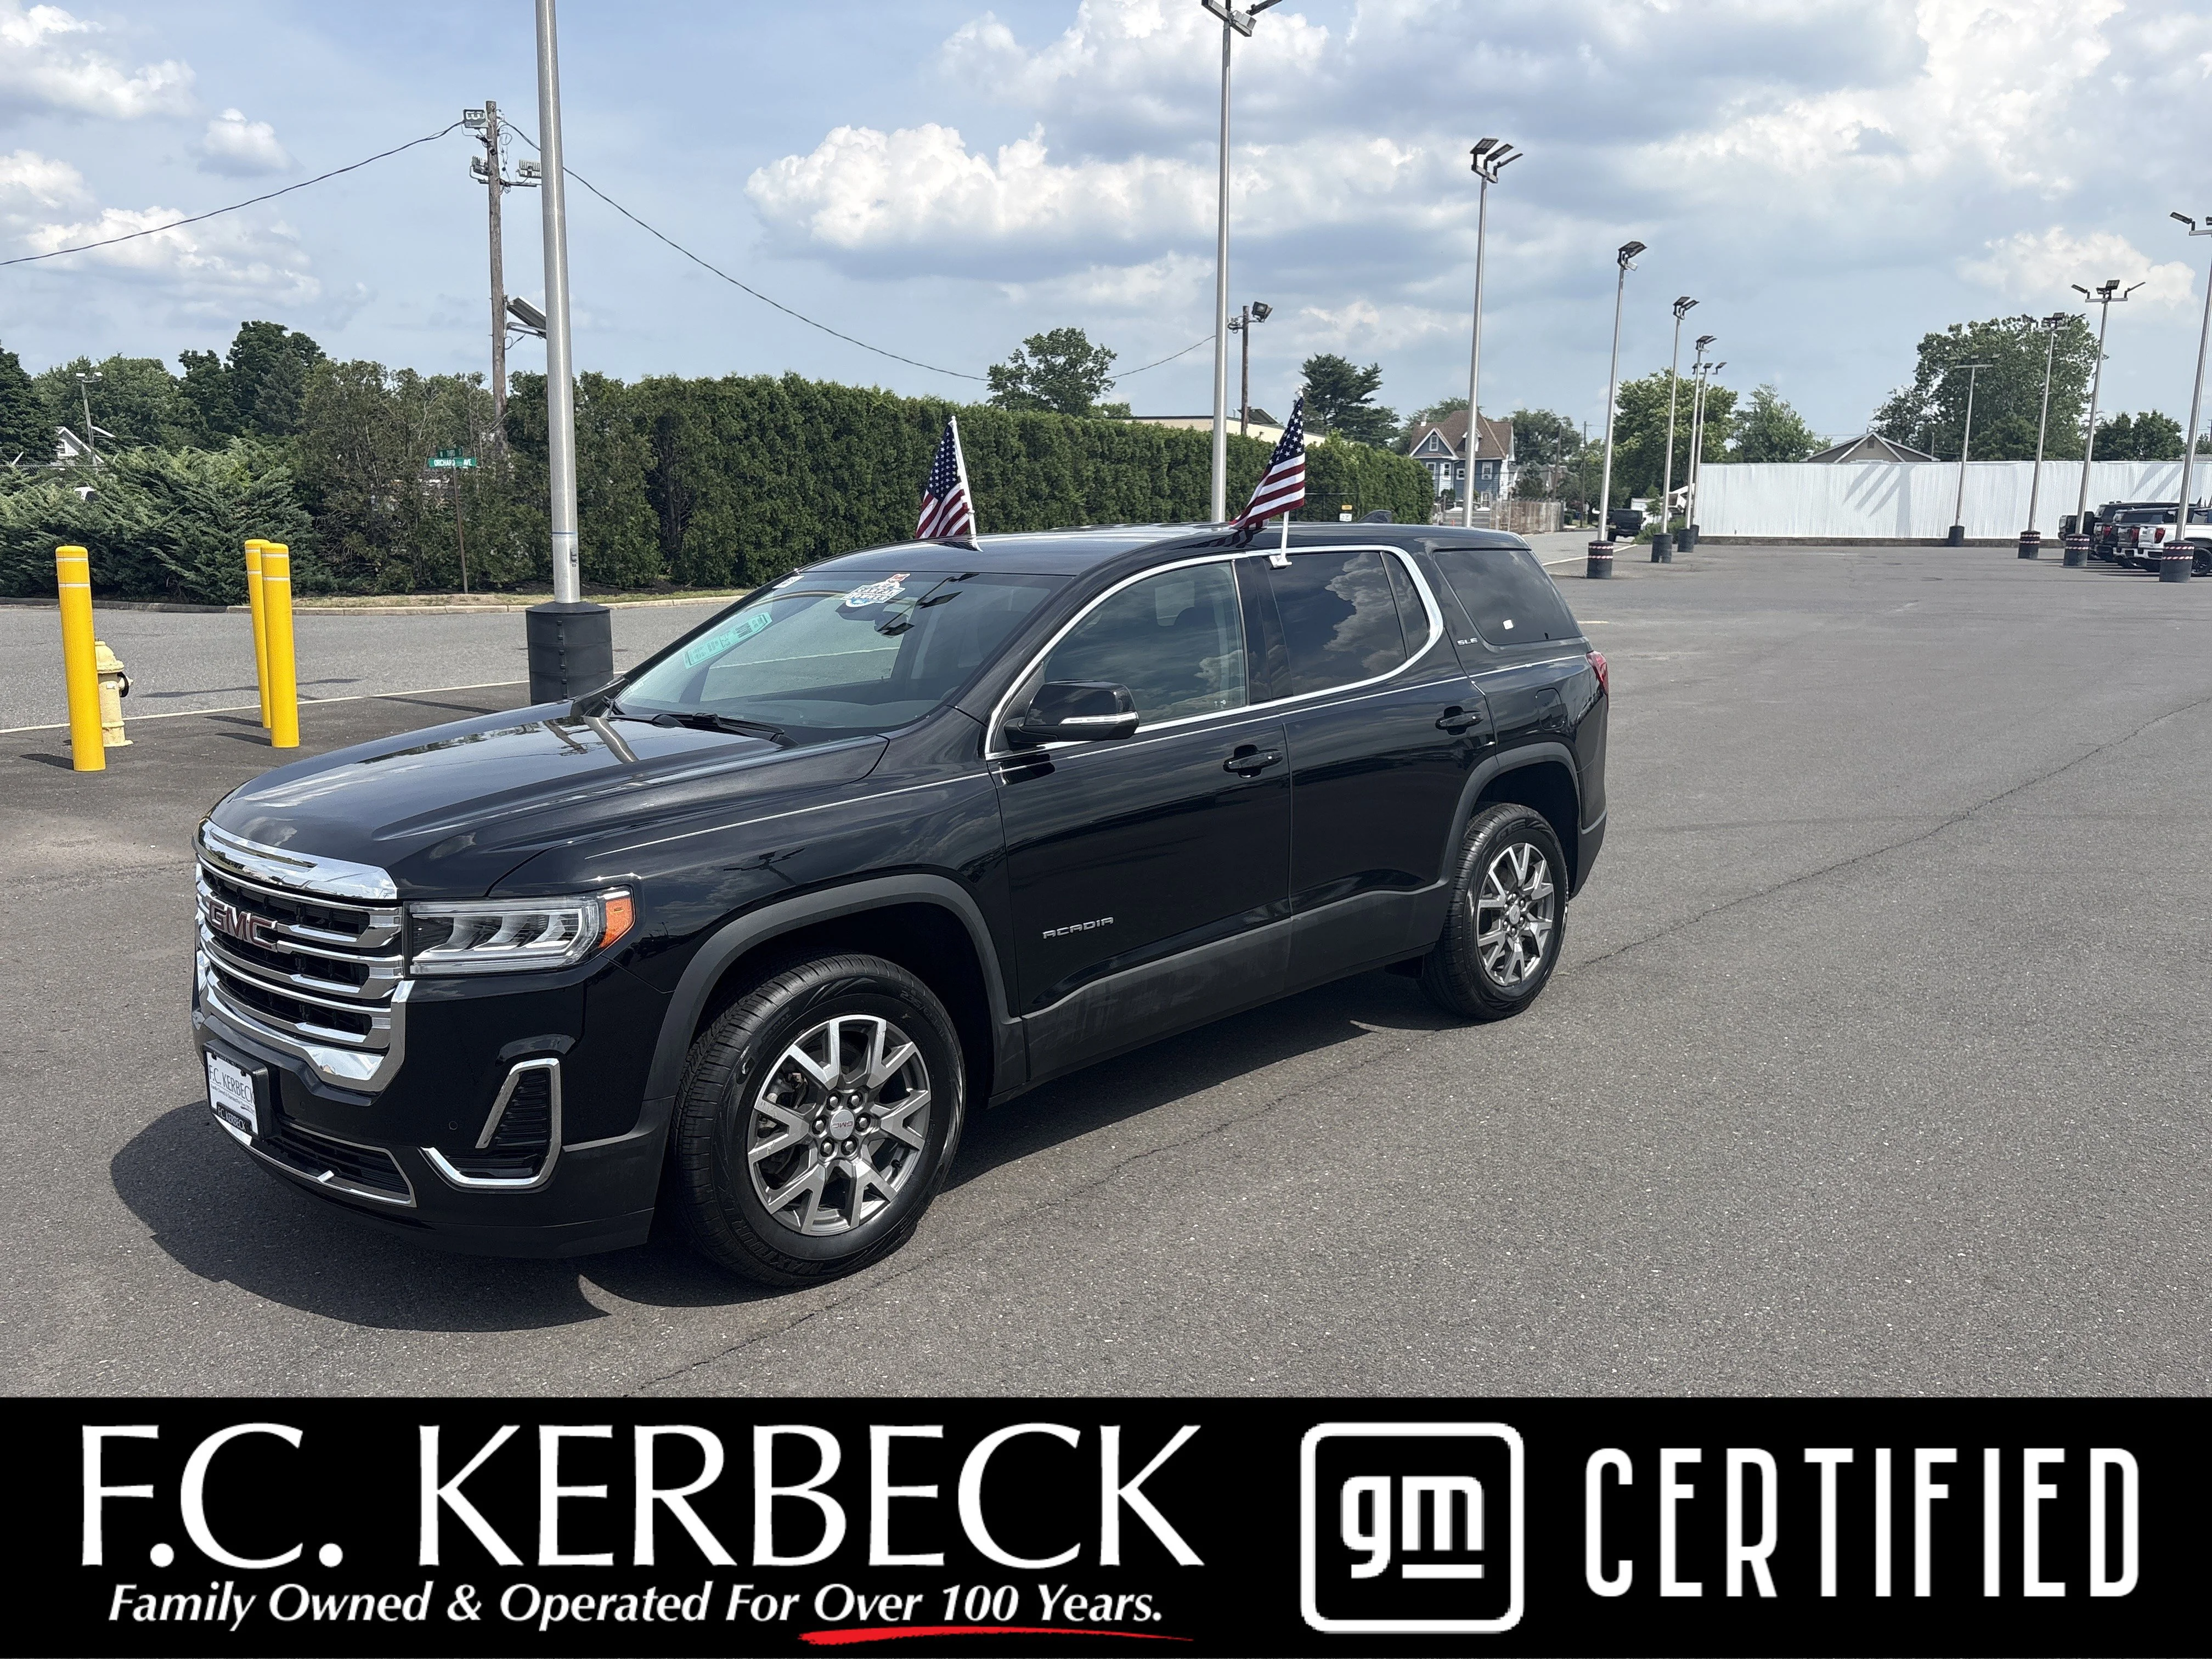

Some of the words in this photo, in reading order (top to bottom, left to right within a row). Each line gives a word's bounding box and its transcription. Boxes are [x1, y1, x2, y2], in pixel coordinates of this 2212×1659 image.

[1457, 637, 1478, 646] SLE
[209, 900, 278, 952] GMC
[1042, 917, 1114, 939] ACADIA
[222, 1072, 255, 1104] KERBECK
[225, 1111, 246, 1132] KERBECK
